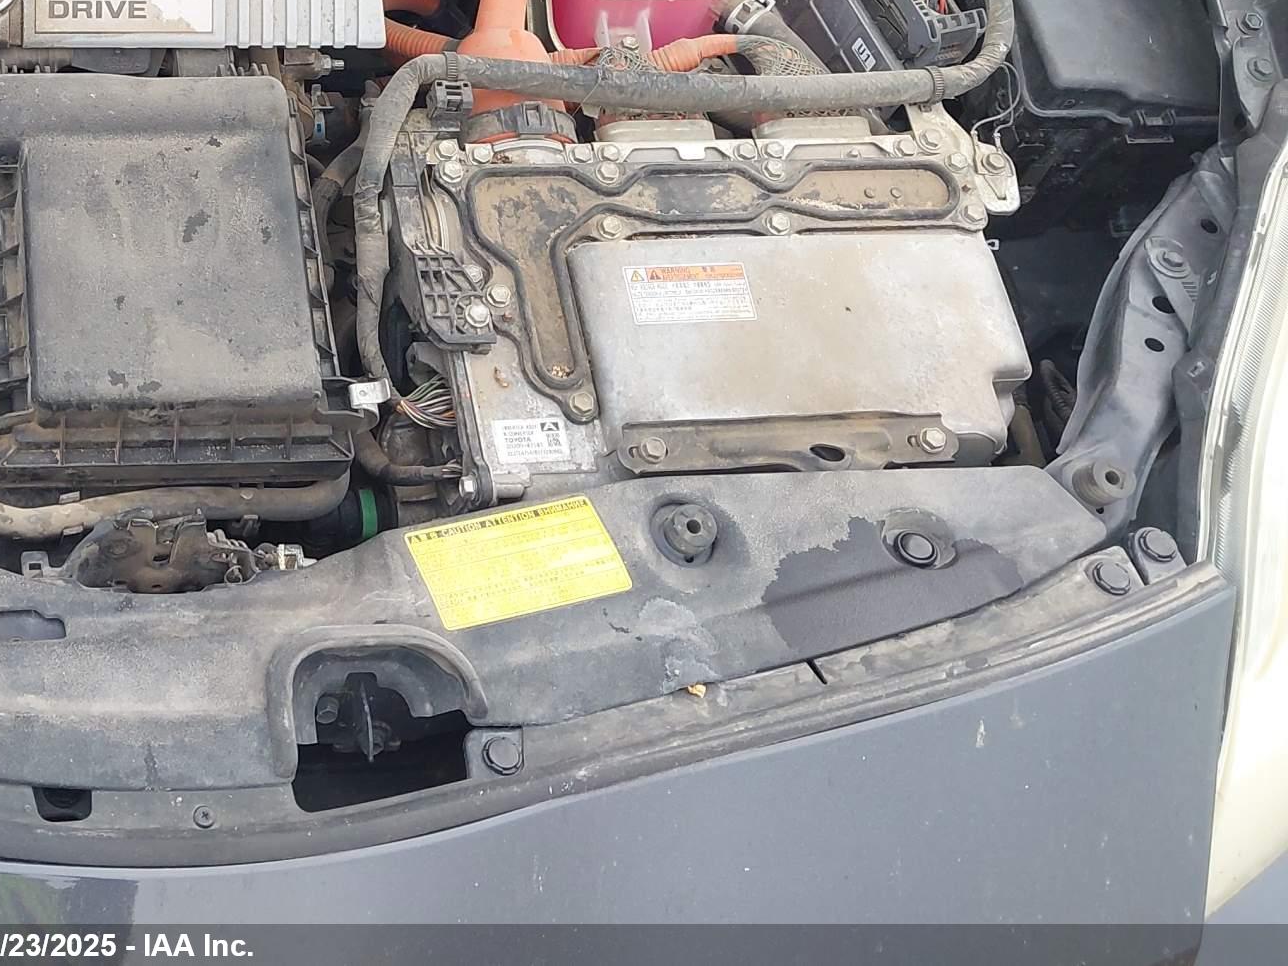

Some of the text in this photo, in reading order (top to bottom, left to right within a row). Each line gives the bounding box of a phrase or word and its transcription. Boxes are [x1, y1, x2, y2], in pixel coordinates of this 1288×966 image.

[48, 0, 148, 19] DRIVE
[857, 43, 870, 62] U1
[441, 520, 482, 537] CAUTION
[486, 510, 534, 529] ATTENTION
